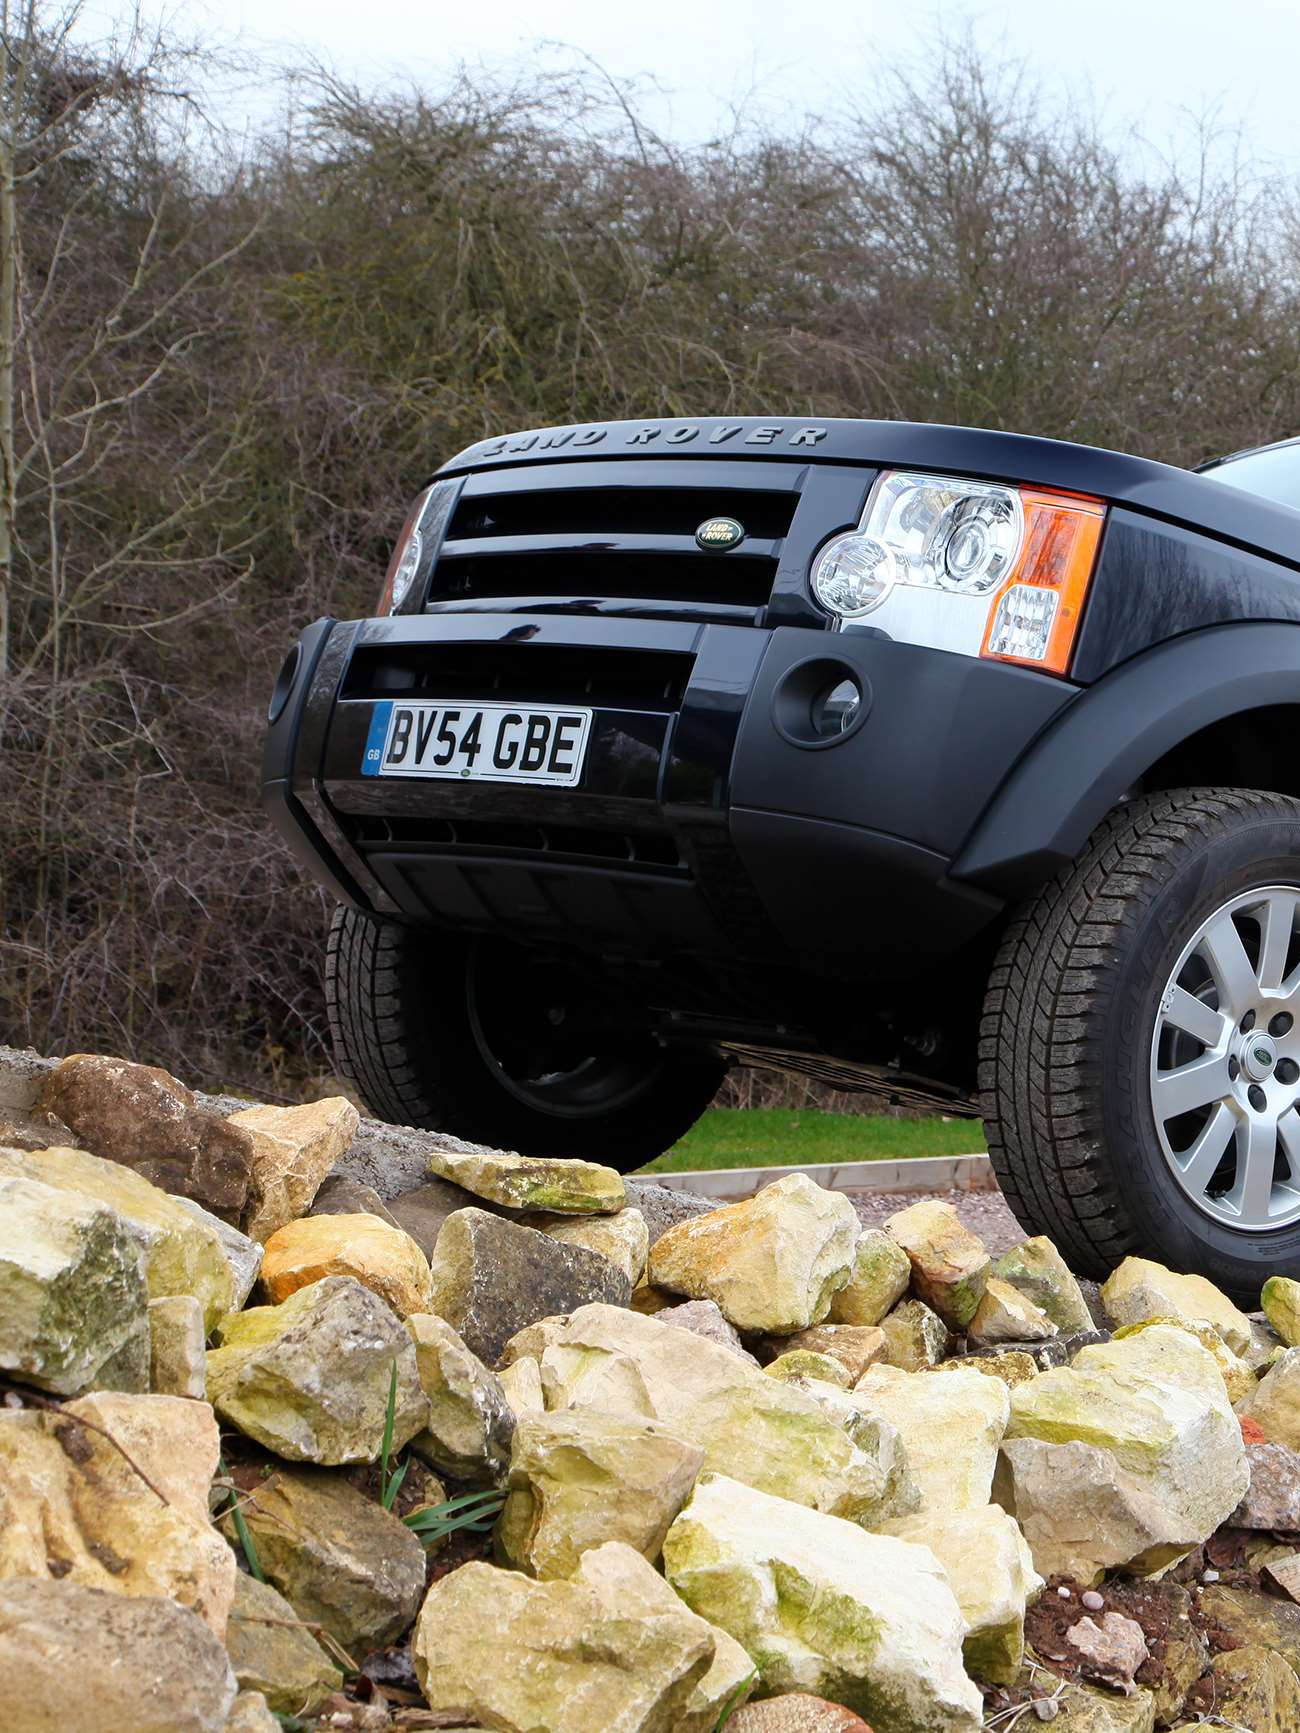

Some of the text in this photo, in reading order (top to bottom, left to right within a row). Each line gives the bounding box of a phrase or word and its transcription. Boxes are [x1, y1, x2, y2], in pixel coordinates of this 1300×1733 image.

[484, 425, 828, 458] LAND ROVER
[705, 523, 730, 532] LAND
[705, 532, 733, 541] ROVER
[386, 710, 582, 774] BV54 GBE
[367, 749, 380, 761] GB
